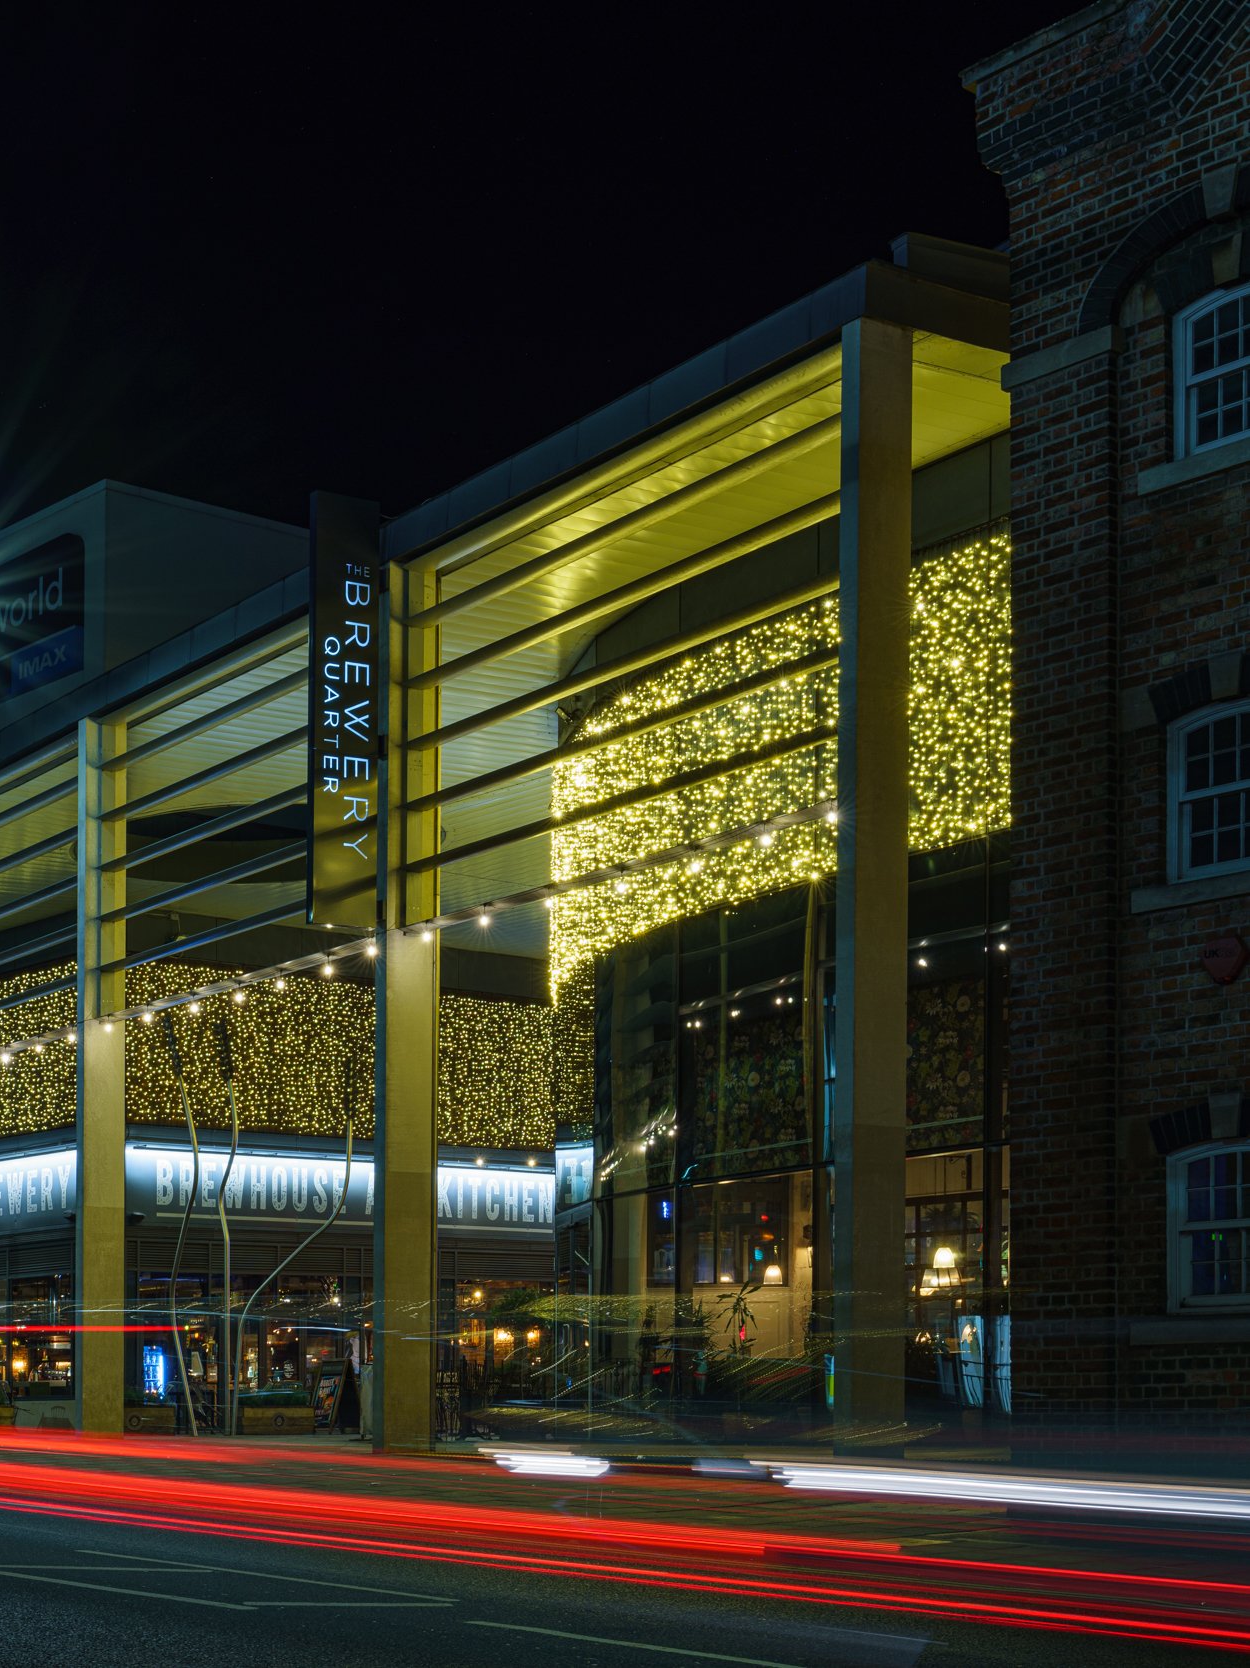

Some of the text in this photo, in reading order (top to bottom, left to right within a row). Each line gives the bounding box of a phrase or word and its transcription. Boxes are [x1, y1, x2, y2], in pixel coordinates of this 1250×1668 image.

[345, 563, 370, 578] THE
[18, 644, 67, 681] IMAX
[323, 636, 341, 793] QUARTER
[343, 580, 371, 859] BREWERY
[156, 1159, 347, 1214] BREWHOUSE
[438, 1175, 553, 1224] KITCHEN
